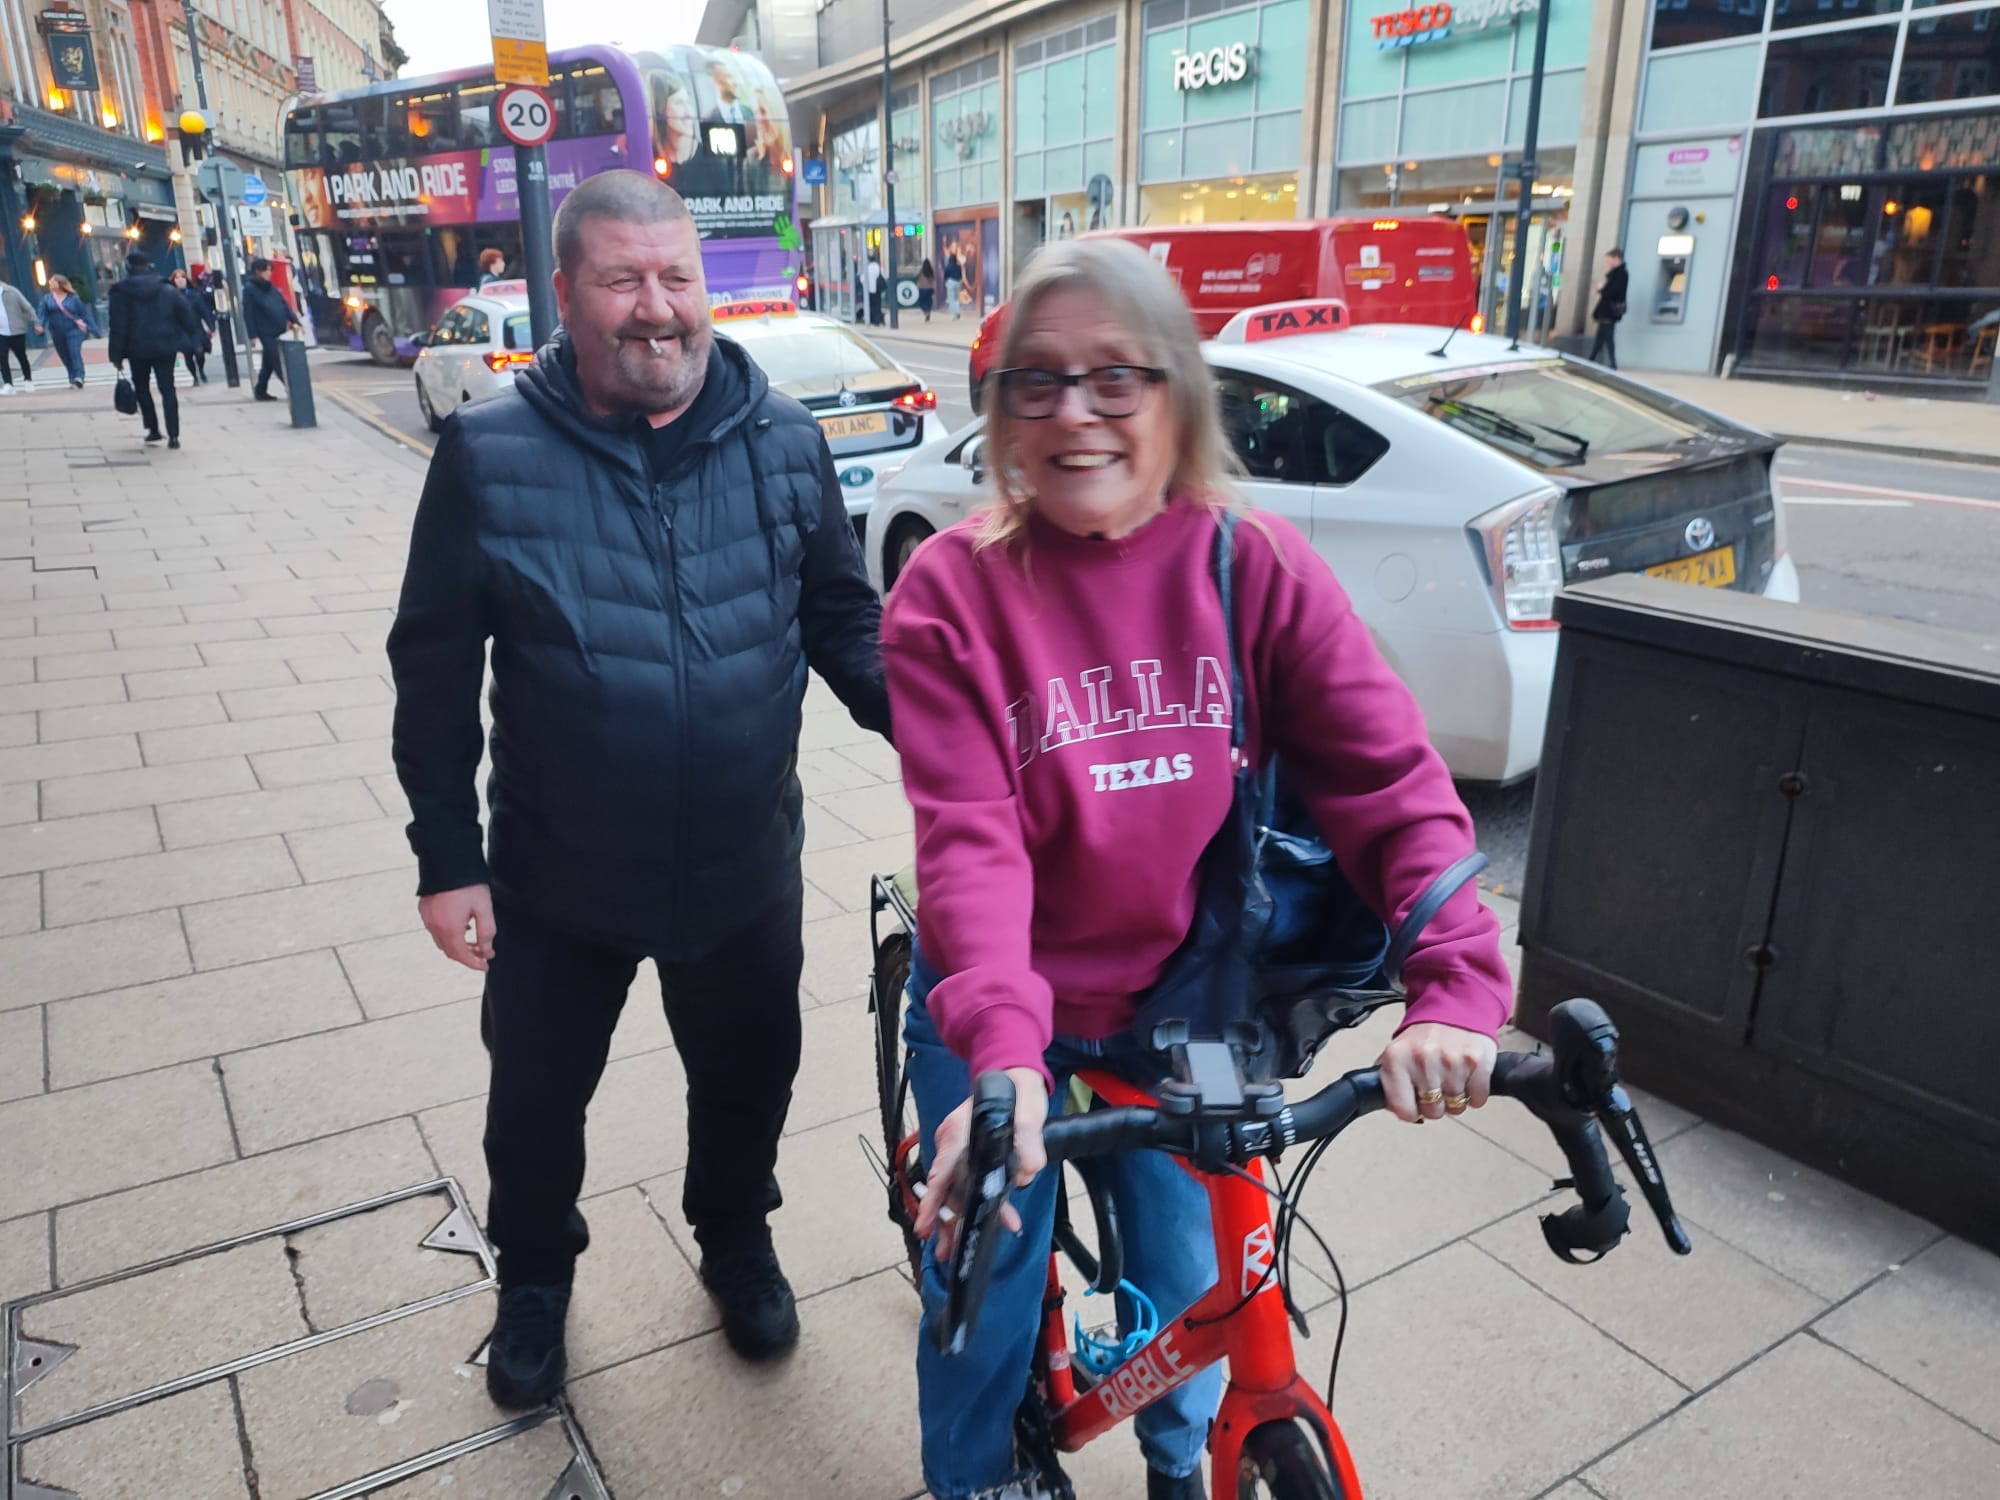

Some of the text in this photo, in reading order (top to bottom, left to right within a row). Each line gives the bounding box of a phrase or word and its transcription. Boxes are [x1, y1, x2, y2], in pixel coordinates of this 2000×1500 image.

[1370, 3, 1452, 38] TESCO
[507, 103, 548, 127] 20
[323, 162, 469, 204] I PARK AND RIDE
[684, 194, 784, 213] PARK AND RIDE
[726, 302, 790, 316] TAXI
[1254, 307, 1341, 332] TAXI
[1004, 656, 1233, 773] DALLA
[1088, 752, 1194, 792] TEXAS
[1097, 1331, 1196, 1421] RIBBLE
